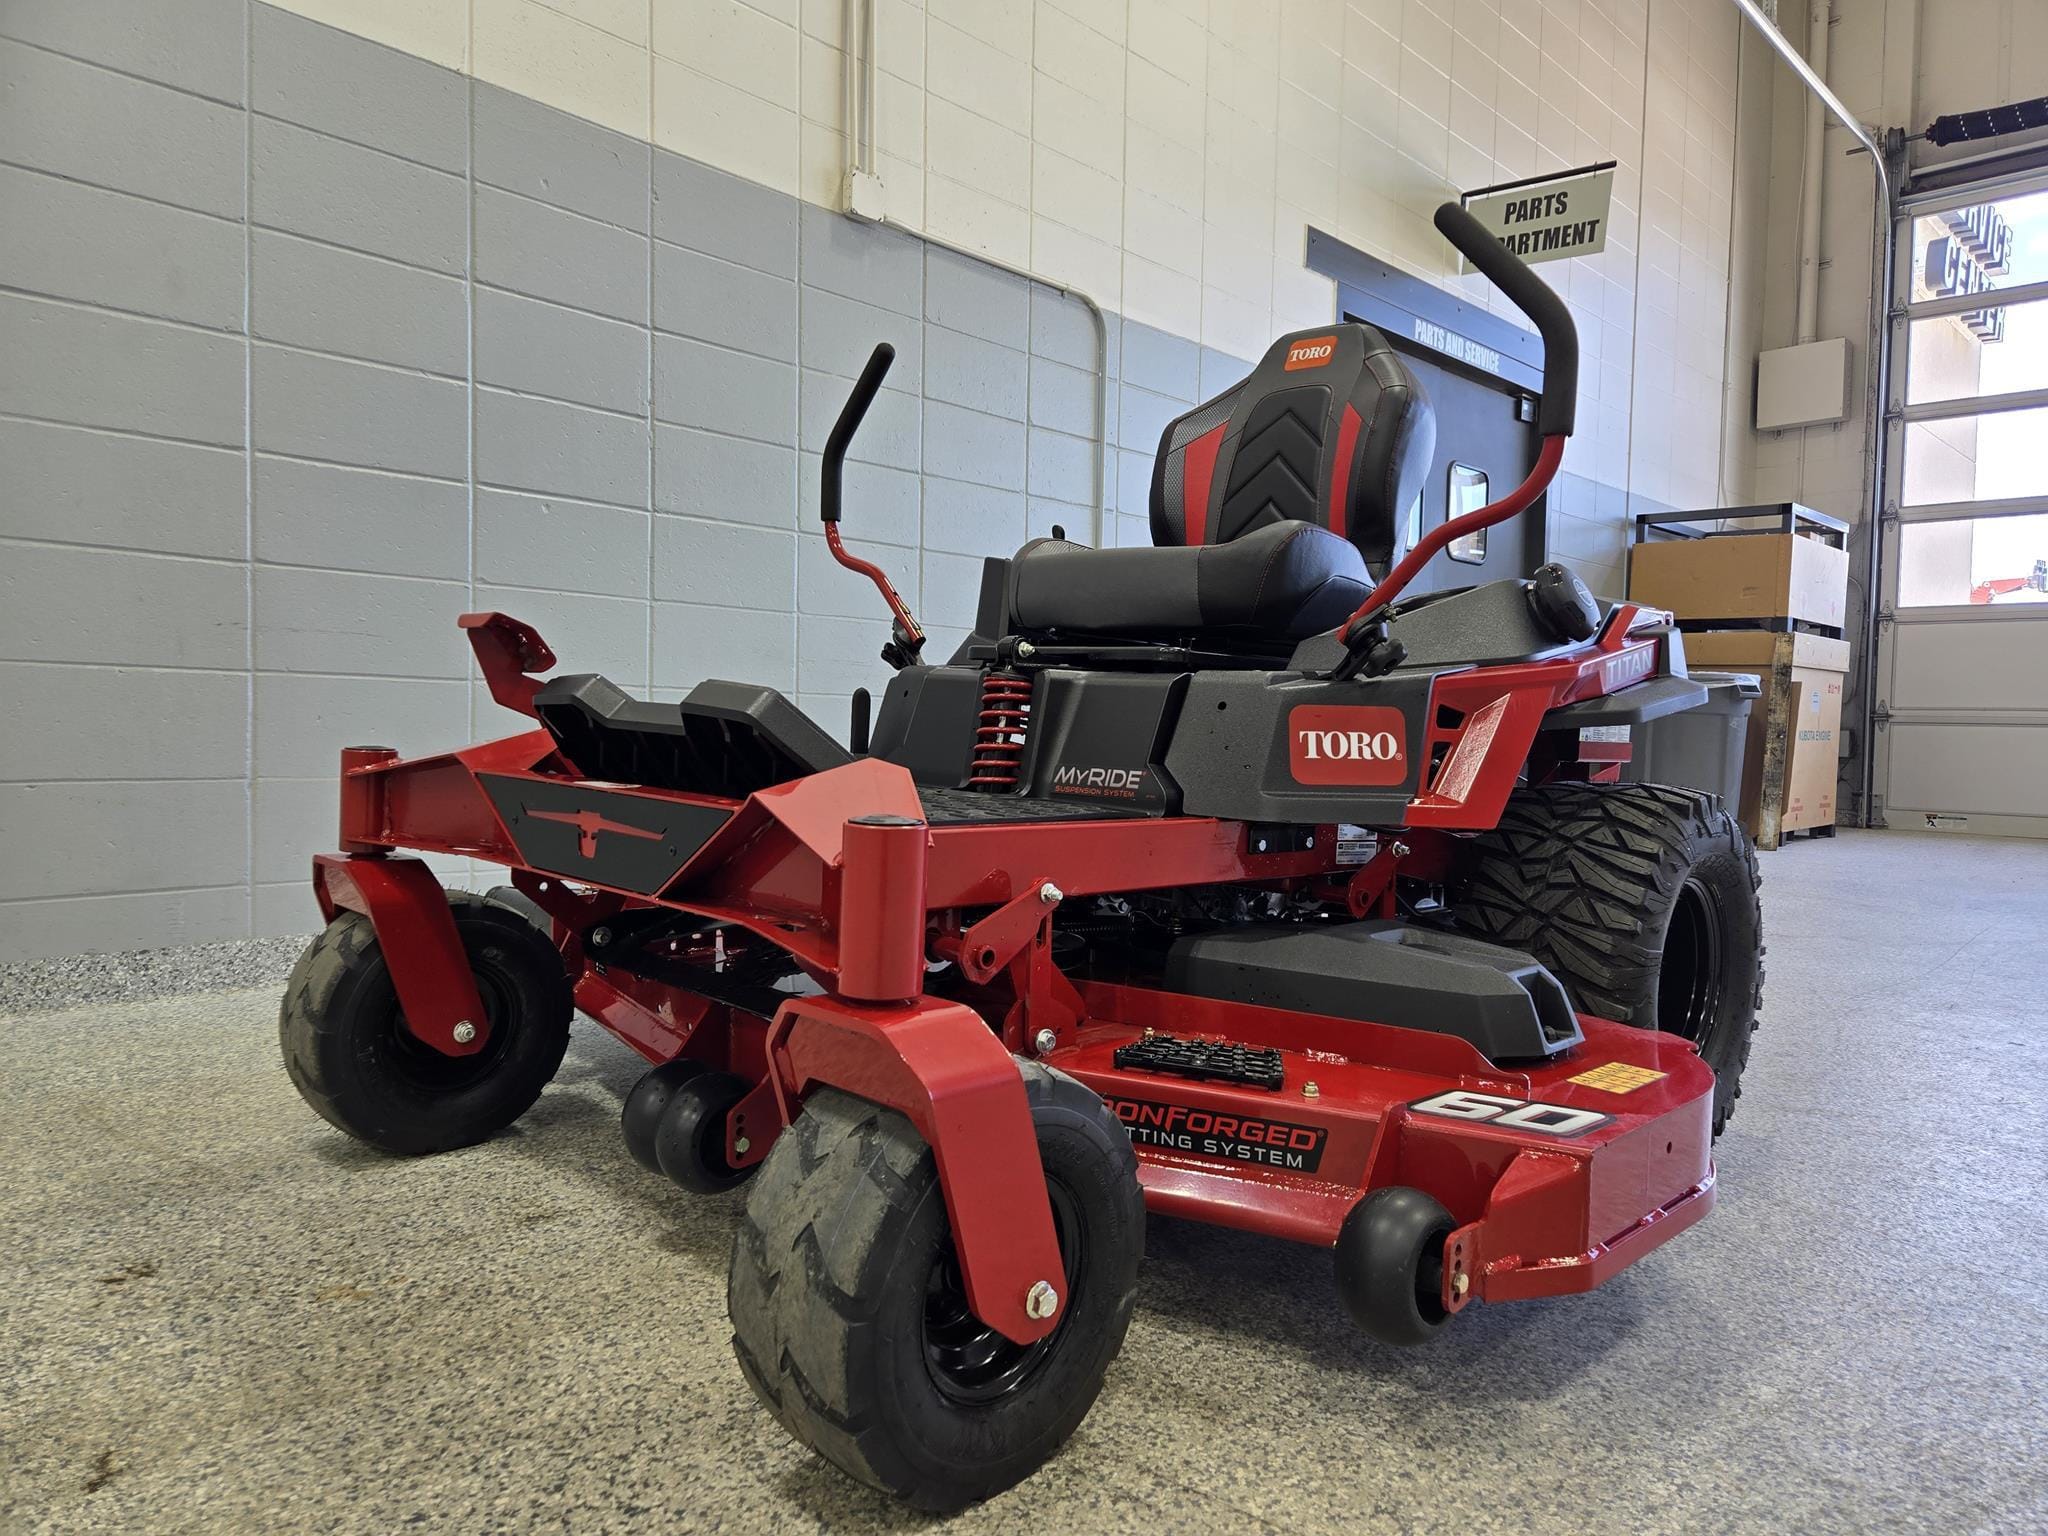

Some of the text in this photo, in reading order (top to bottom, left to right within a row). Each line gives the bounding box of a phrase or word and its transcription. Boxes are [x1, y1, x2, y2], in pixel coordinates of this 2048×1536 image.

[1503, 191, 1568, 225] PARTS
[1496, 218, 1600, 256] ARTMENT
[1290, 345, 1331, 362] TORO
[1414, 318, 1500, 373] PARTS AND SERVICE
[1606, 647, 1653, 684] TITAN
[1055, 785, 1101, 795] SUSPENSION
[1104, 789, 1135, 798] SYSTEM
[1102, 1098, 1318, 1151] ONFORGED
[1410, 1090, 1606, 1133] 60
[1125, 1126, 1304, 1169] TTING SYSTEM
